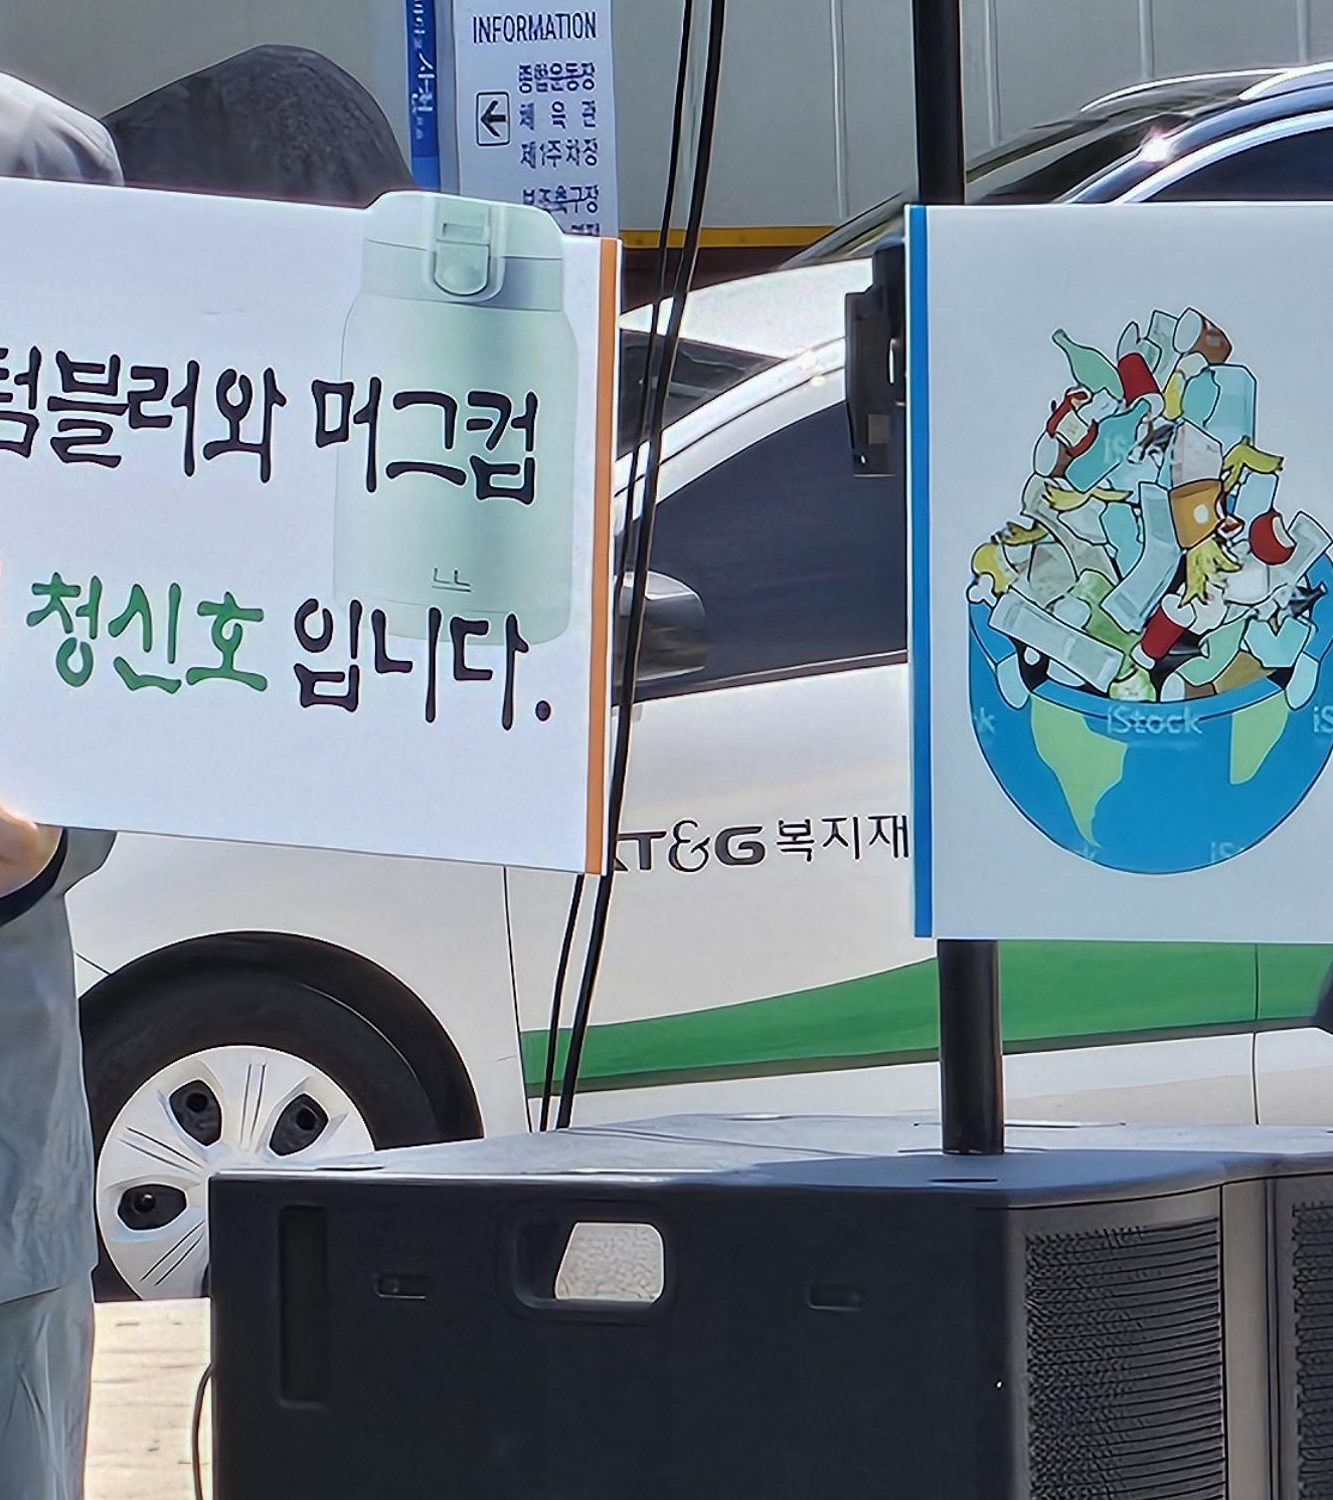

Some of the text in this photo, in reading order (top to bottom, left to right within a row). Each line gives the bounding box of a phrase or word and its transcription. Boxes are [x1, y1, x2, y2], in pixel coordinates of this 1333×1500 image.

[472, 10, 598, 47] INFORMATION
[311, 376, 539, 506] 머그컵
[24, 571, 269, 695] 청신호
[292, 597, 553, 731] 입니다.
[1106, 706, 1203, 736] iStock
[614, 814, 910, 873] T&G 복지재
